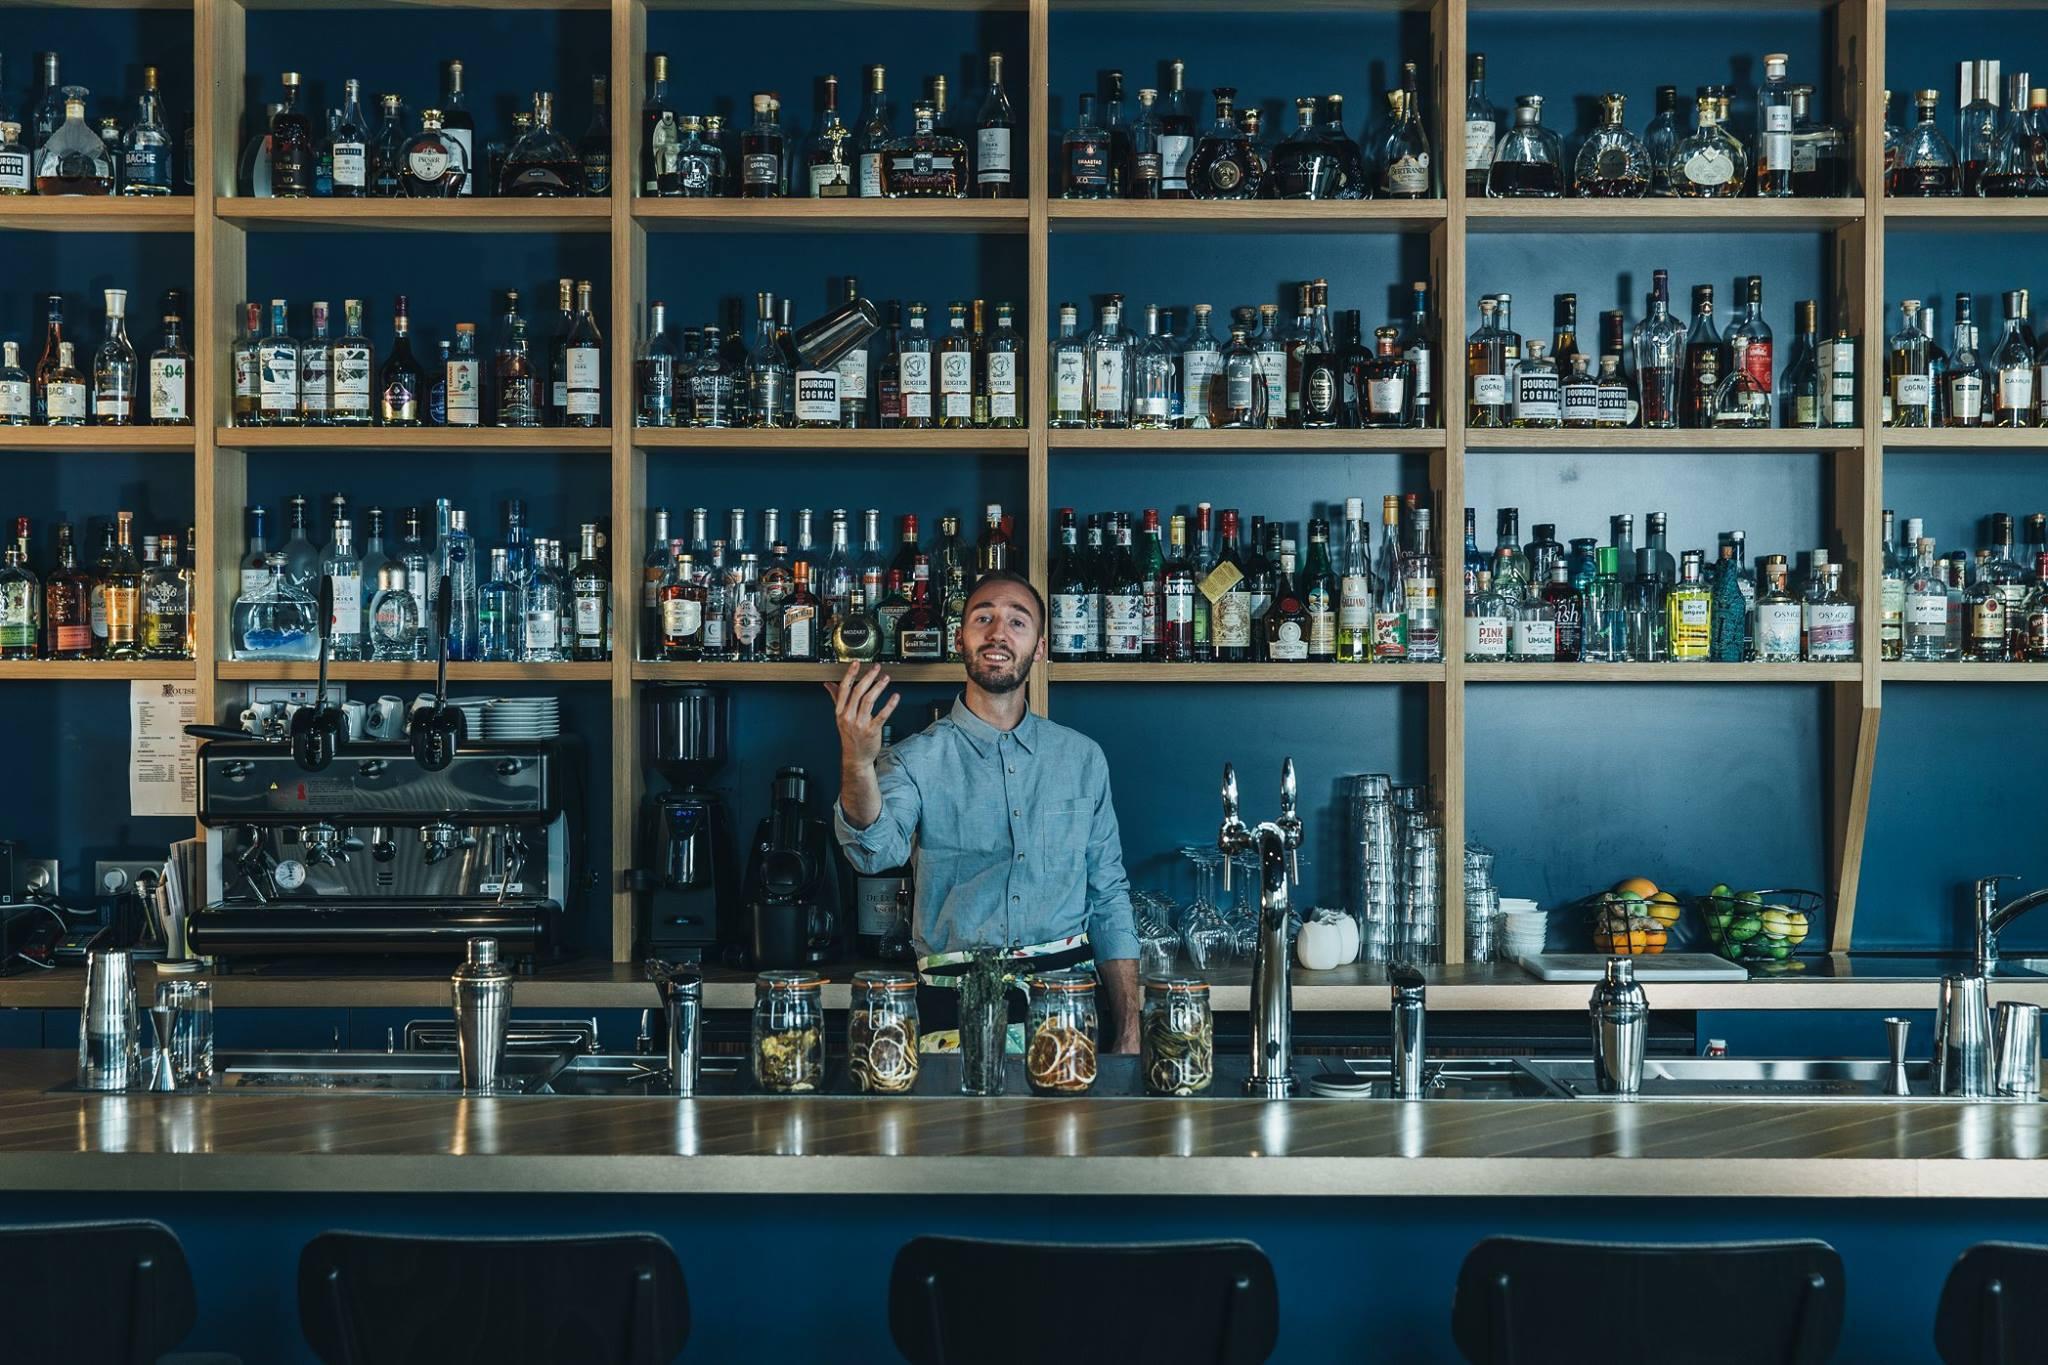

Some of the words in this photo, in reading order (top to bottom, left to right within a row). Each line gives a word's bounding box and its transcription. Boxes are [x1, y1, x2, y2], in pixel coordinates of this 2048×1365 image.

[801, 380, 834, 389] BOURGOIN
[801, 390, 834, 399] COGNAC
[1522, 391, 1557, 400] COGNAC
[573, 582, 605, 590] RICARD
[1163, 584, 1196, 594] CAMPAR
[1479, 627, 1503, 637] PINK
